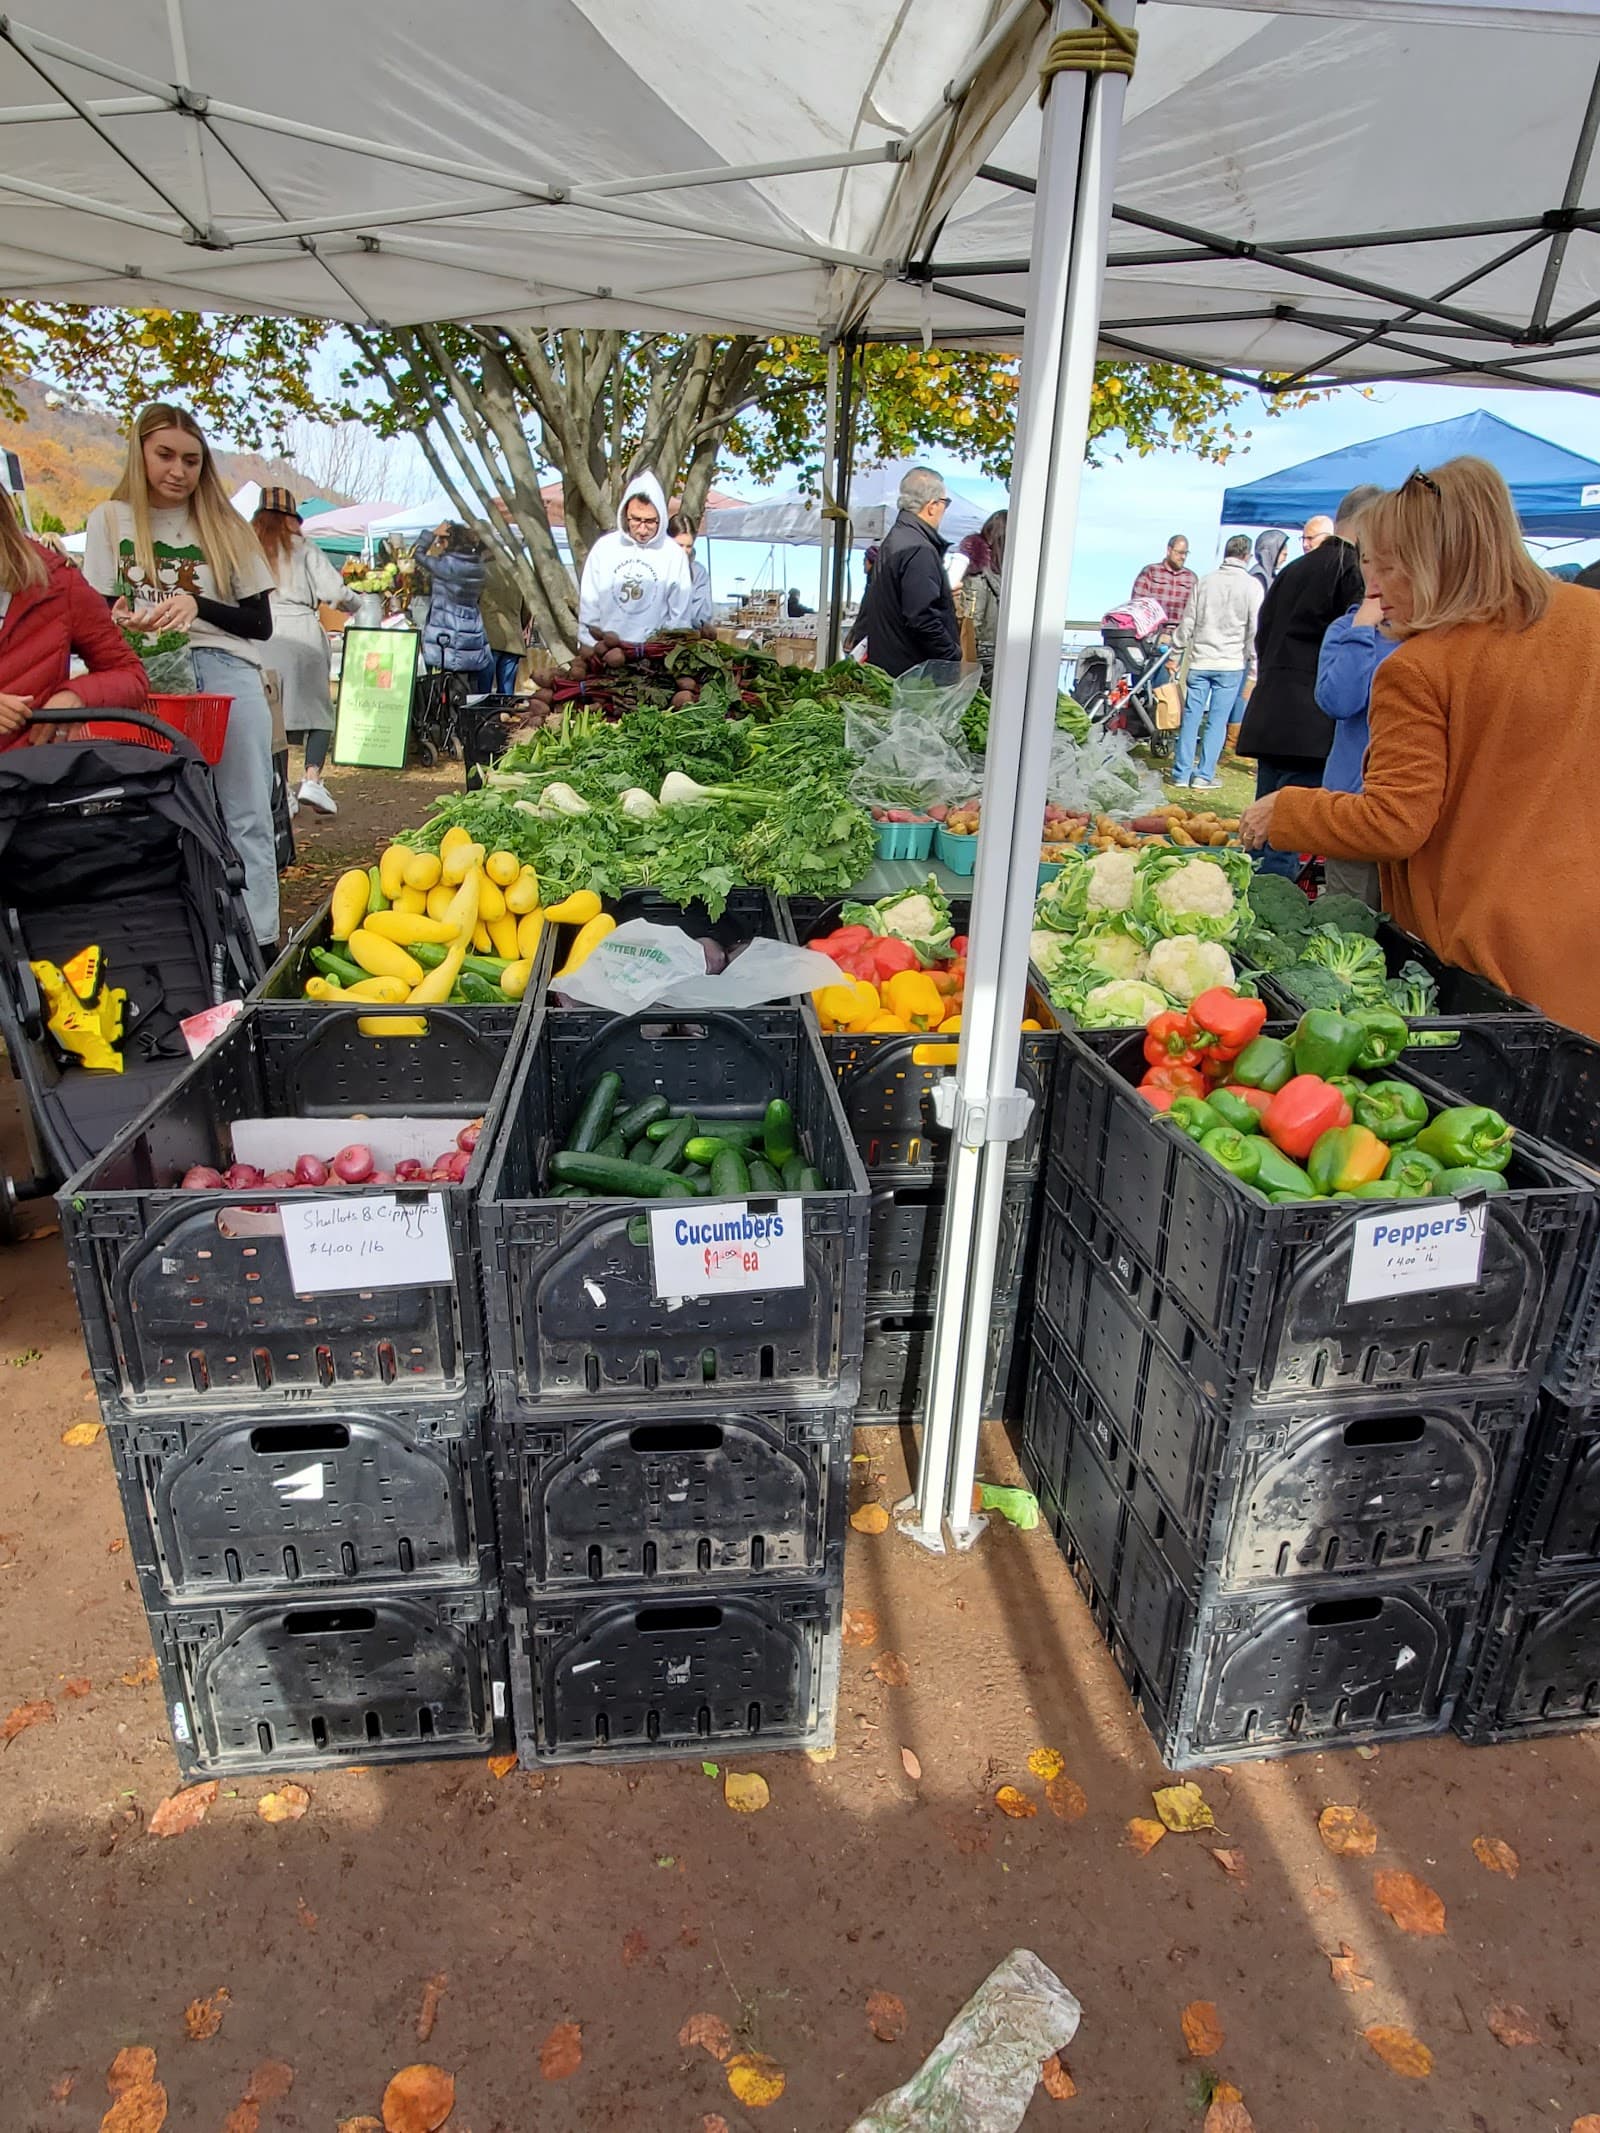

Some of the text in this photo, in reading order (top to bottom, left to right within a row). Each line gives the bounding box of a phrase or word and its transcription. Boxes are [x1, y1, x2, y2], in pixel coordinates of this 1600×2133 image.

[362, 1206, 374, 1222] &
[675, 1213, 784, 1246] Cucumbers
[1372, 1216, 1468, 1247] Peppers
[743, 1251, 759, 1272] ea
